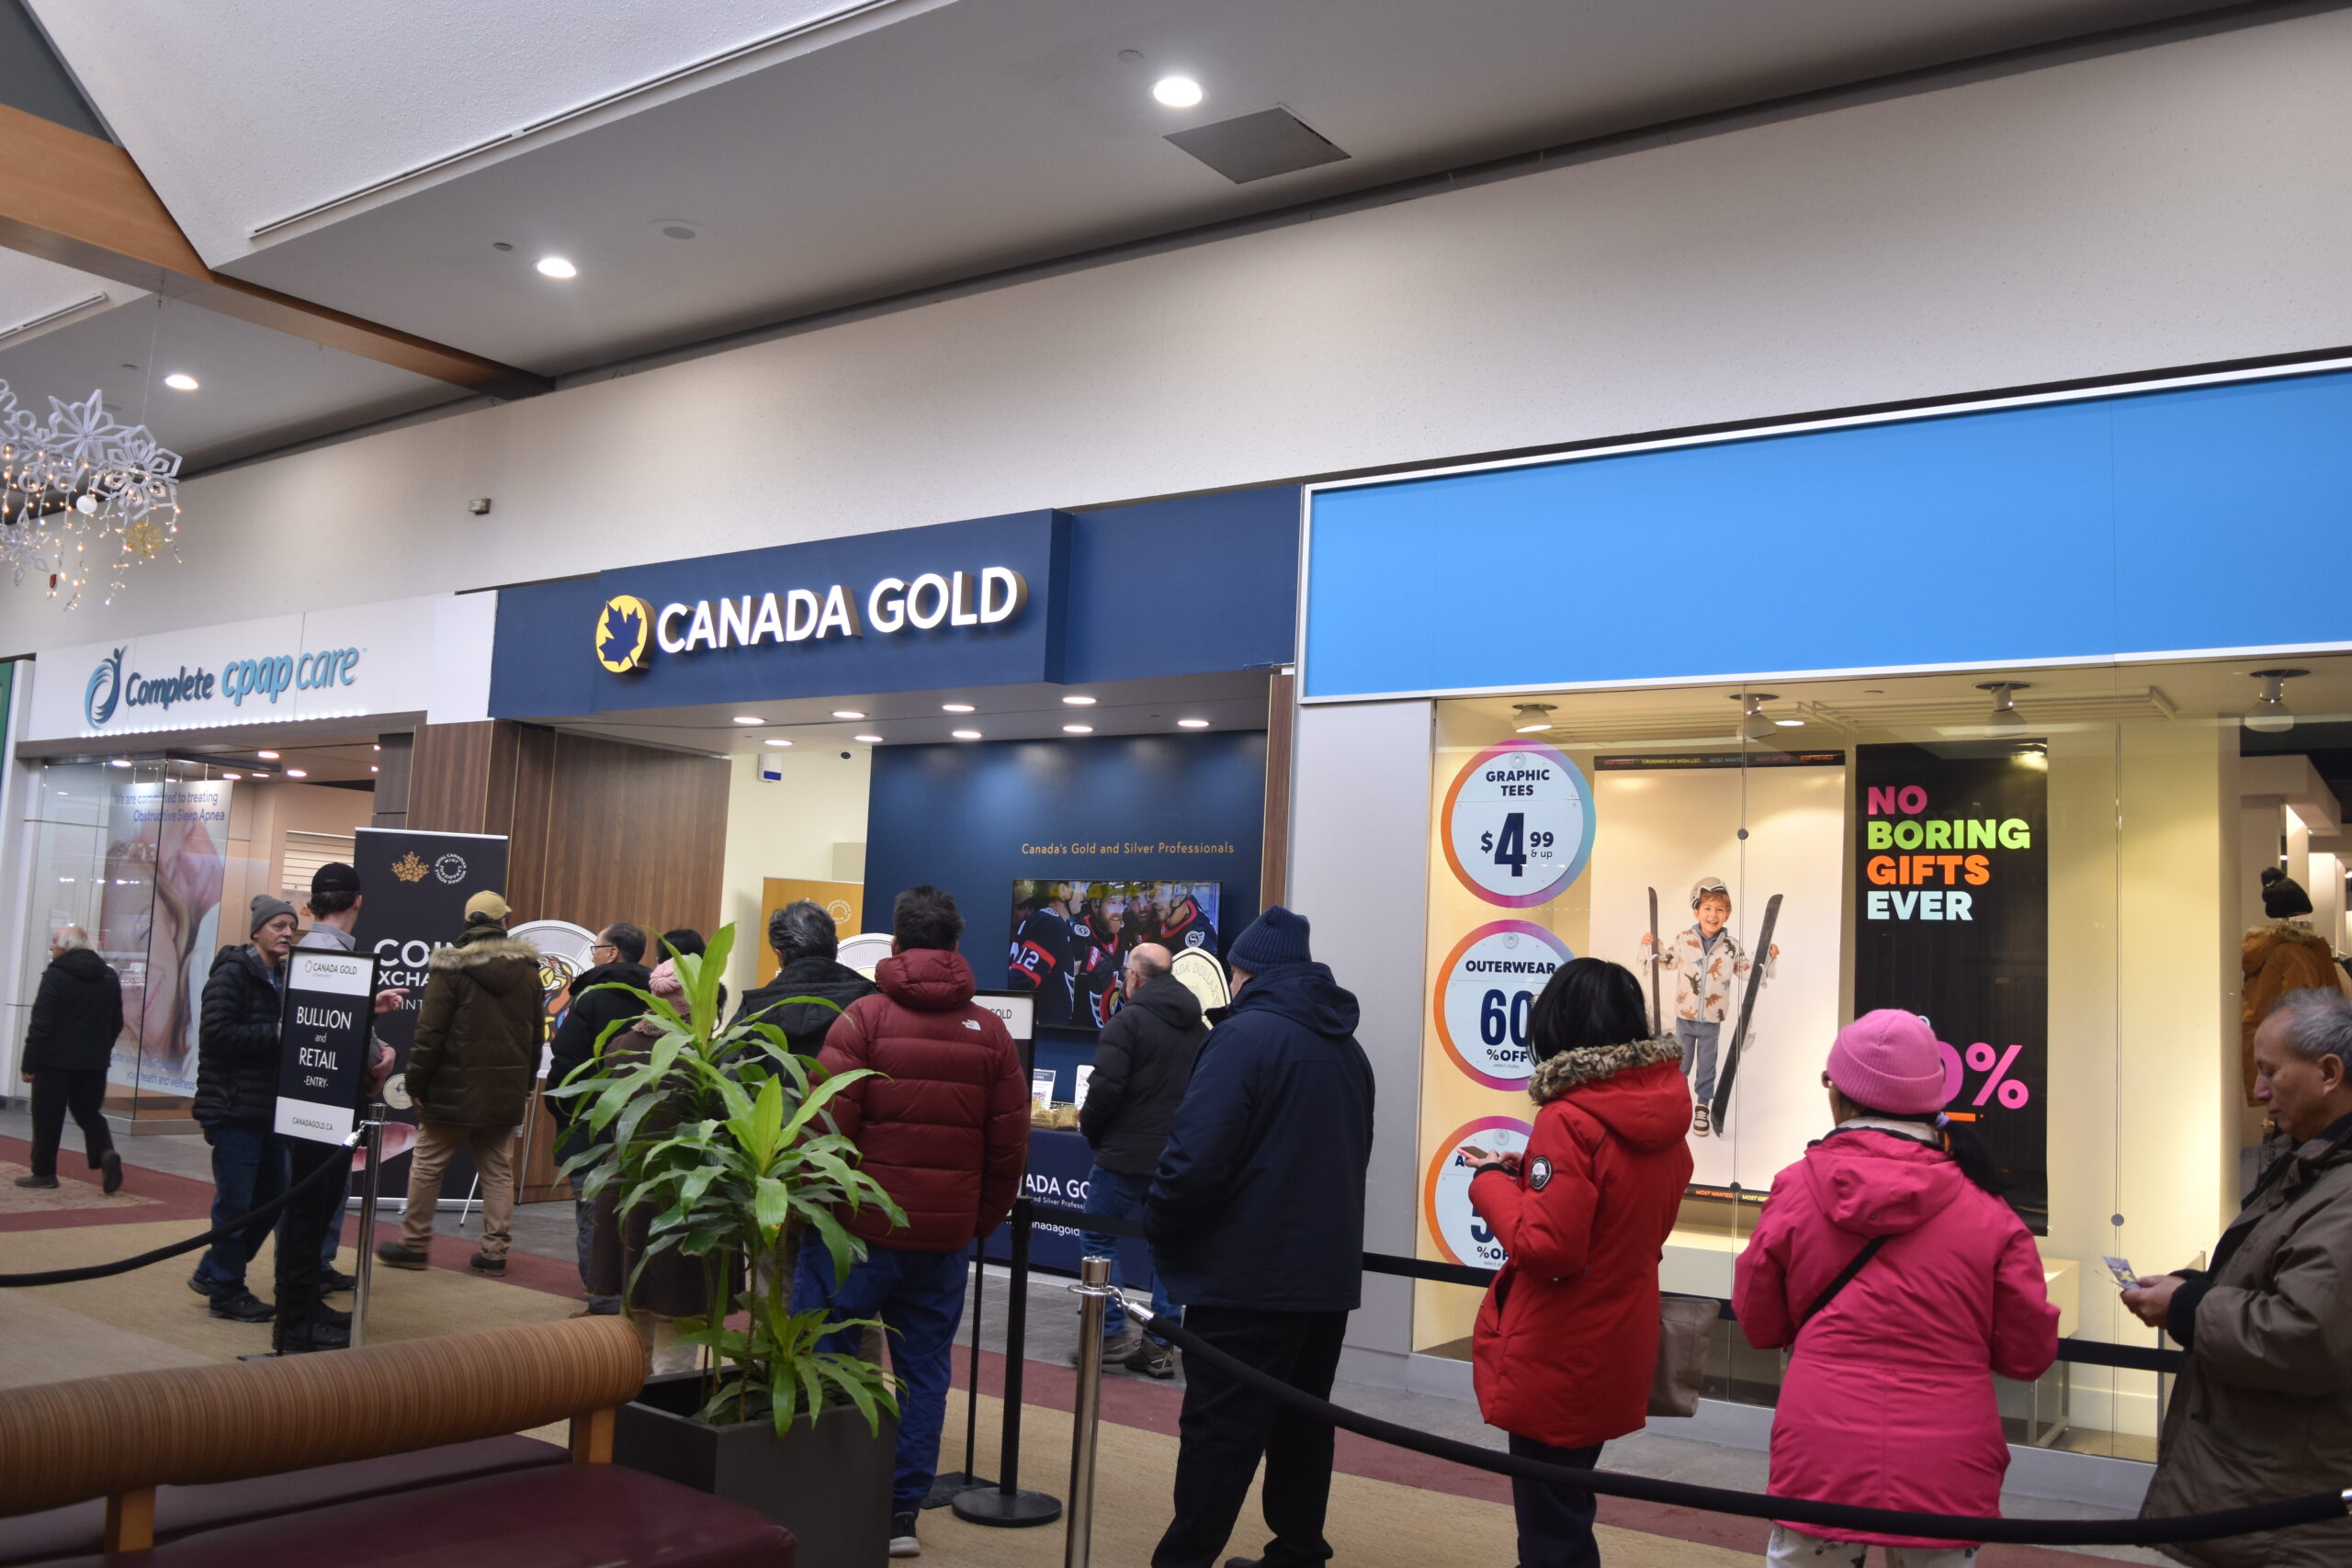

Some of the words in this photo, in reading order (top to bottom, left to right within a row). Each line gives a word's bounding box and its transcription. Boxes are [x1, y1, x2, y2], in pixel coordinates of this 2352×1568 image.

[657, 585, 852, 654] CANADA
[867, 566, 1018, 633] GOLD
[125, 666, 215, 711] Complete
[220, 654, 292, 706] cpap
[295, 646, 359, 690] care
[1486, 769, 1550, 782] GRAPHIC
[1500, 784, 1533, 796] TEES
[138, 792, 176, 804] commited
[178, 794, 187, 803] to
[187, 790, 219, 806] treating
[1867, 784, 1928, 815] NO
[133, 809, 176, 822] Obstrucive
[177, 808, 198, 823] Sleep
[199, 808, 225, 823] Apnea
[1867, 818, 2030, 850] BORING
[1022, 843, 1068, 854] Canada's
[1071, 842, 1096, 854] Gold
[1101, 842, 1120, 854] and
[1124, 842, 1154, 853] Silver
[1159, 841, 1235, 853] Professionals
[1531, 850, 1537, 858] &
[1541, 851, 1553, 859] up
[1867, 854, 1990, 886] GIFTS
[1867, 890, 1973, 920] EVER
[374, 939, 455, 968] CO
[312, 962, 339, 974] CANADA
[339, 964, 357, 976] GOLD
[1465, 960, 1556, 974] OUTERWEAR
[296, 1006, 352, 1030] BULLION
[989, 1009, 1012, 1019] OLD
[1480, 988, 1534, 1047] 60
[315, 1032, 326, 1043] and
[299, 1047, 338, 1070] RETAIL
[1487, 1048, 1528, 1063] %OFF
[292, 1117, 333, 1131] CANADAGOLD.CA
[1043, 1196, 1059, 1205] Silver
